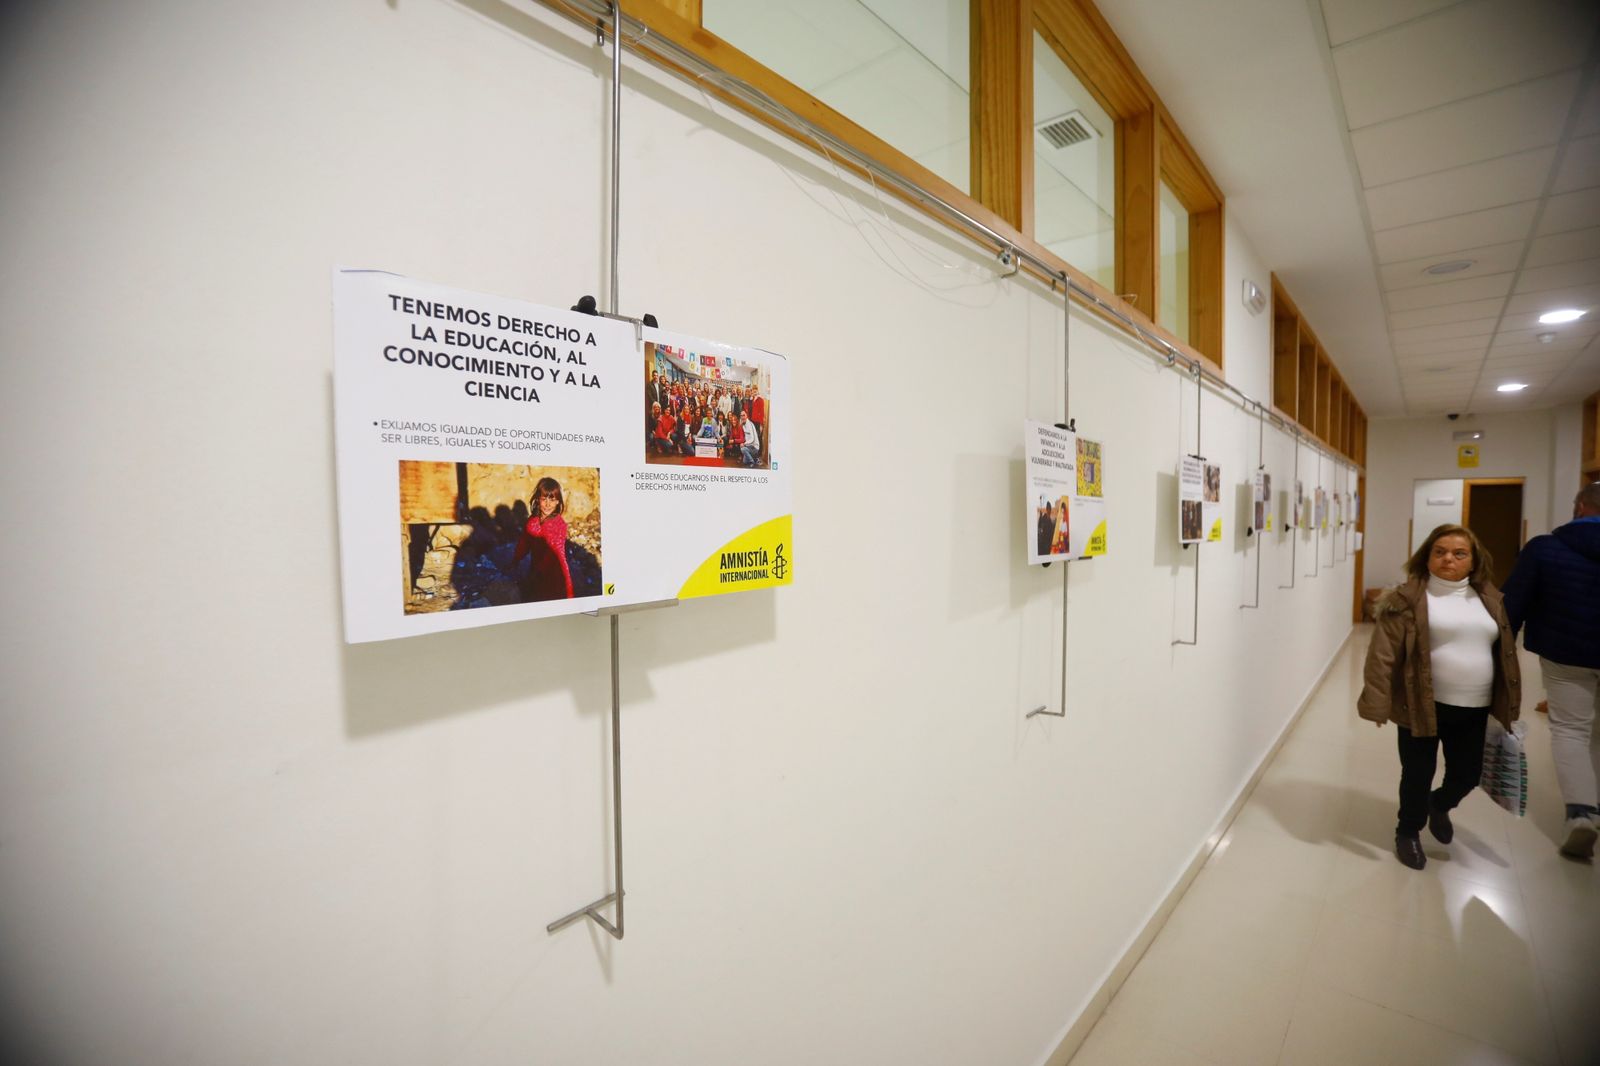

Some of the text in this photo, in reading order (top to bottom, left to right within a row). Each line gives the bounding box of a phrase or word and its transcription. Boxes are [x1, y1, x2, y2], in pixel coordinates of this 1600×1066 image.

[388, 294, 597, 346] TENEMOS DERECHO A
[411, 324, 587, 366] LA EDUCACIÓN, AL
[383, 345, 601, 389] CONOCIMIENTO Y A LA
[464, 380, 541, 403] CIENCIA
[380, 419, 605, 444] EXIJAMOS IGUALDAD DE OPORTUNIDADES PARA
[380, 433, 551, 452] SER LIBRES, IGUALES Y SOLIDARIOS
[635, 472, 669, 481] DEBEMOS
[670, 473, 709, 482] EDUCARNOS
[710, 474, 719, 482] EN
[720, 475, 727, 483] EL
[727, 475, 752, 484] RESPETO
[758, 476, 768, 484] LOS
[635, 482, 706, 492] DERECHOS HUMANOS
[720, 547, 768, 570] AMNISTÍA
[720, 569, 769, 583] INTERNACIONAL
